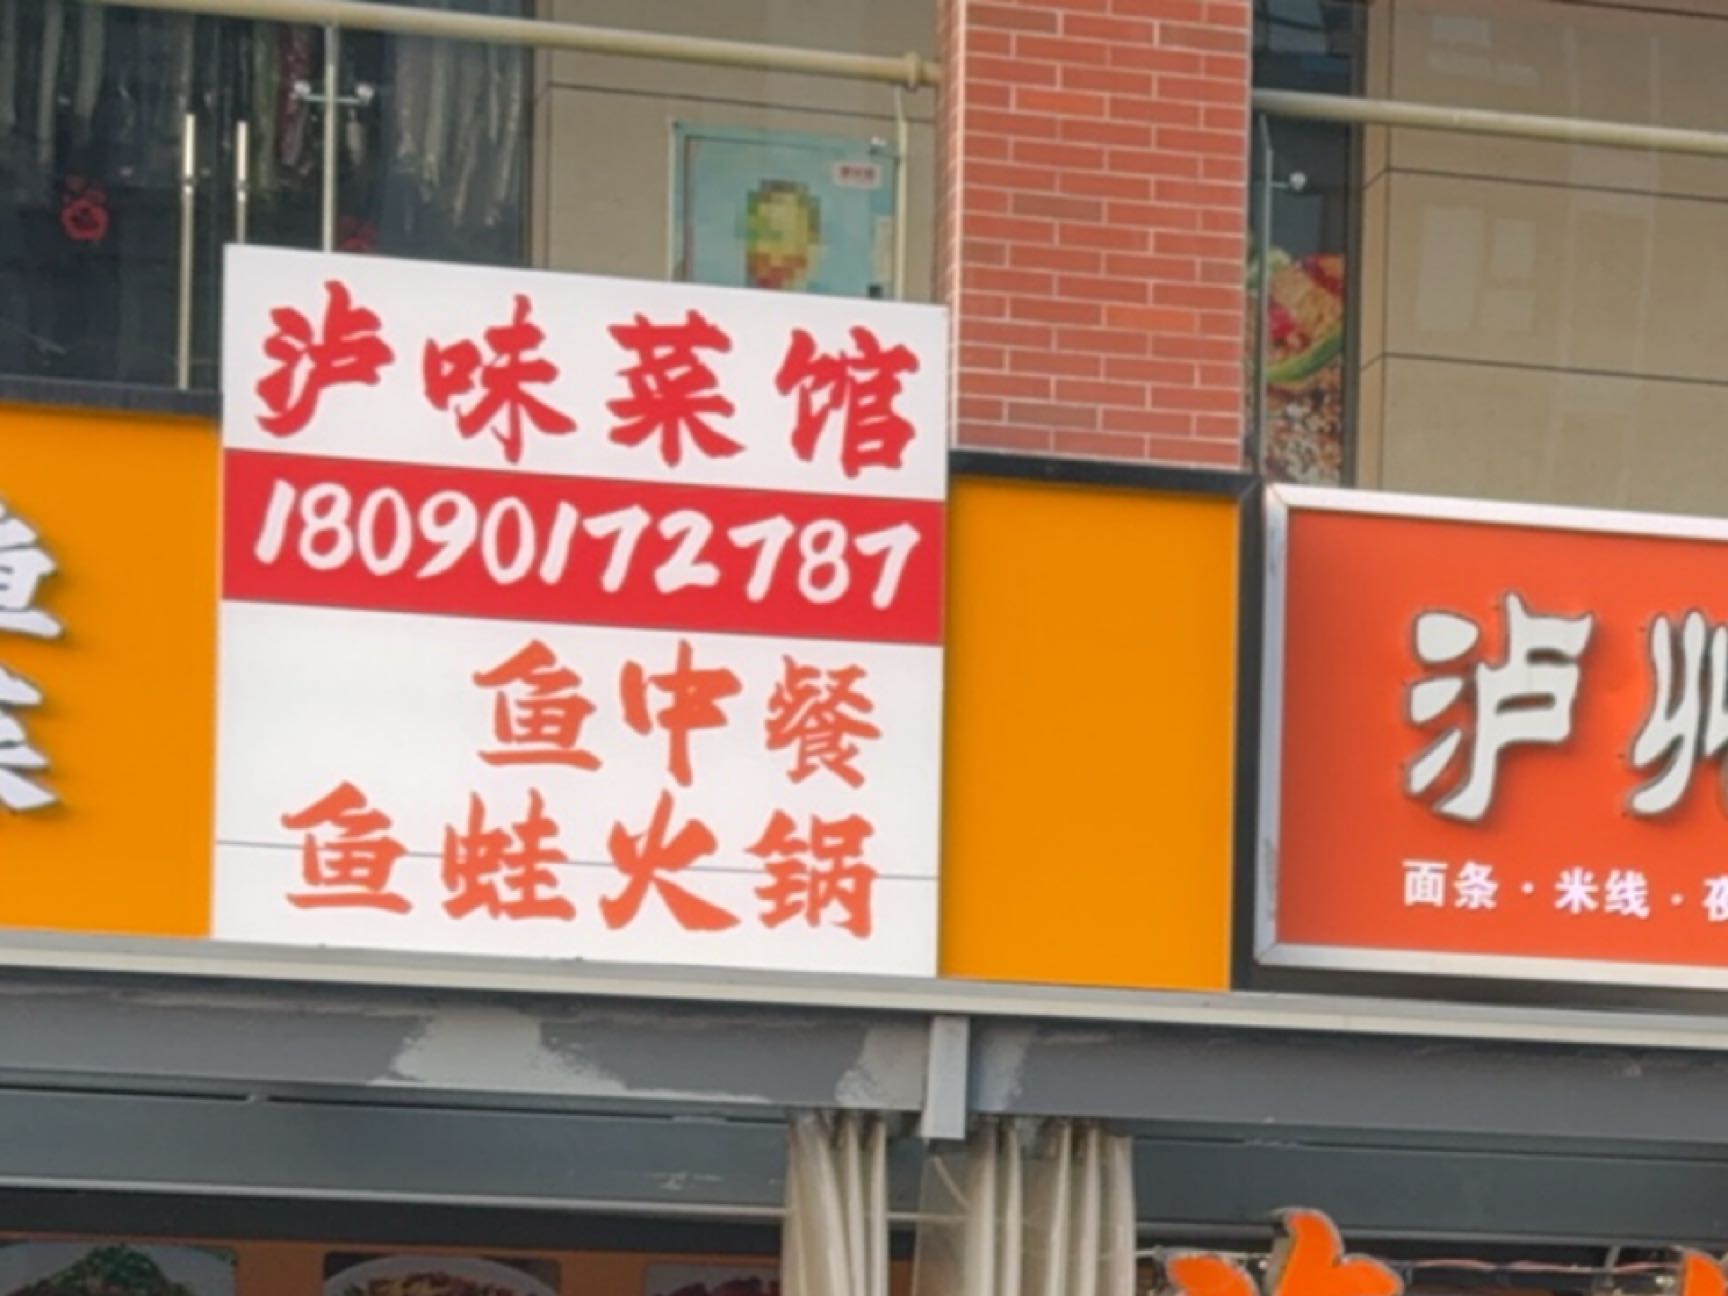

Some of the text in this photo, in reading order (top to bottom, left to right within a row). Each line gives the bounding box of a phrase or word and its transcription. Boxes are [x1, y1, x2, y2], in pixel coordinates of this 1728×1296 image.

[256, 281, 920, 477] 泸味菜馆
[254, 480, 921, 610] 18090172787
[472, 638, 882, 788] 鱼中餐
[280, 780, 880, 940] 鱼蛙火锅
